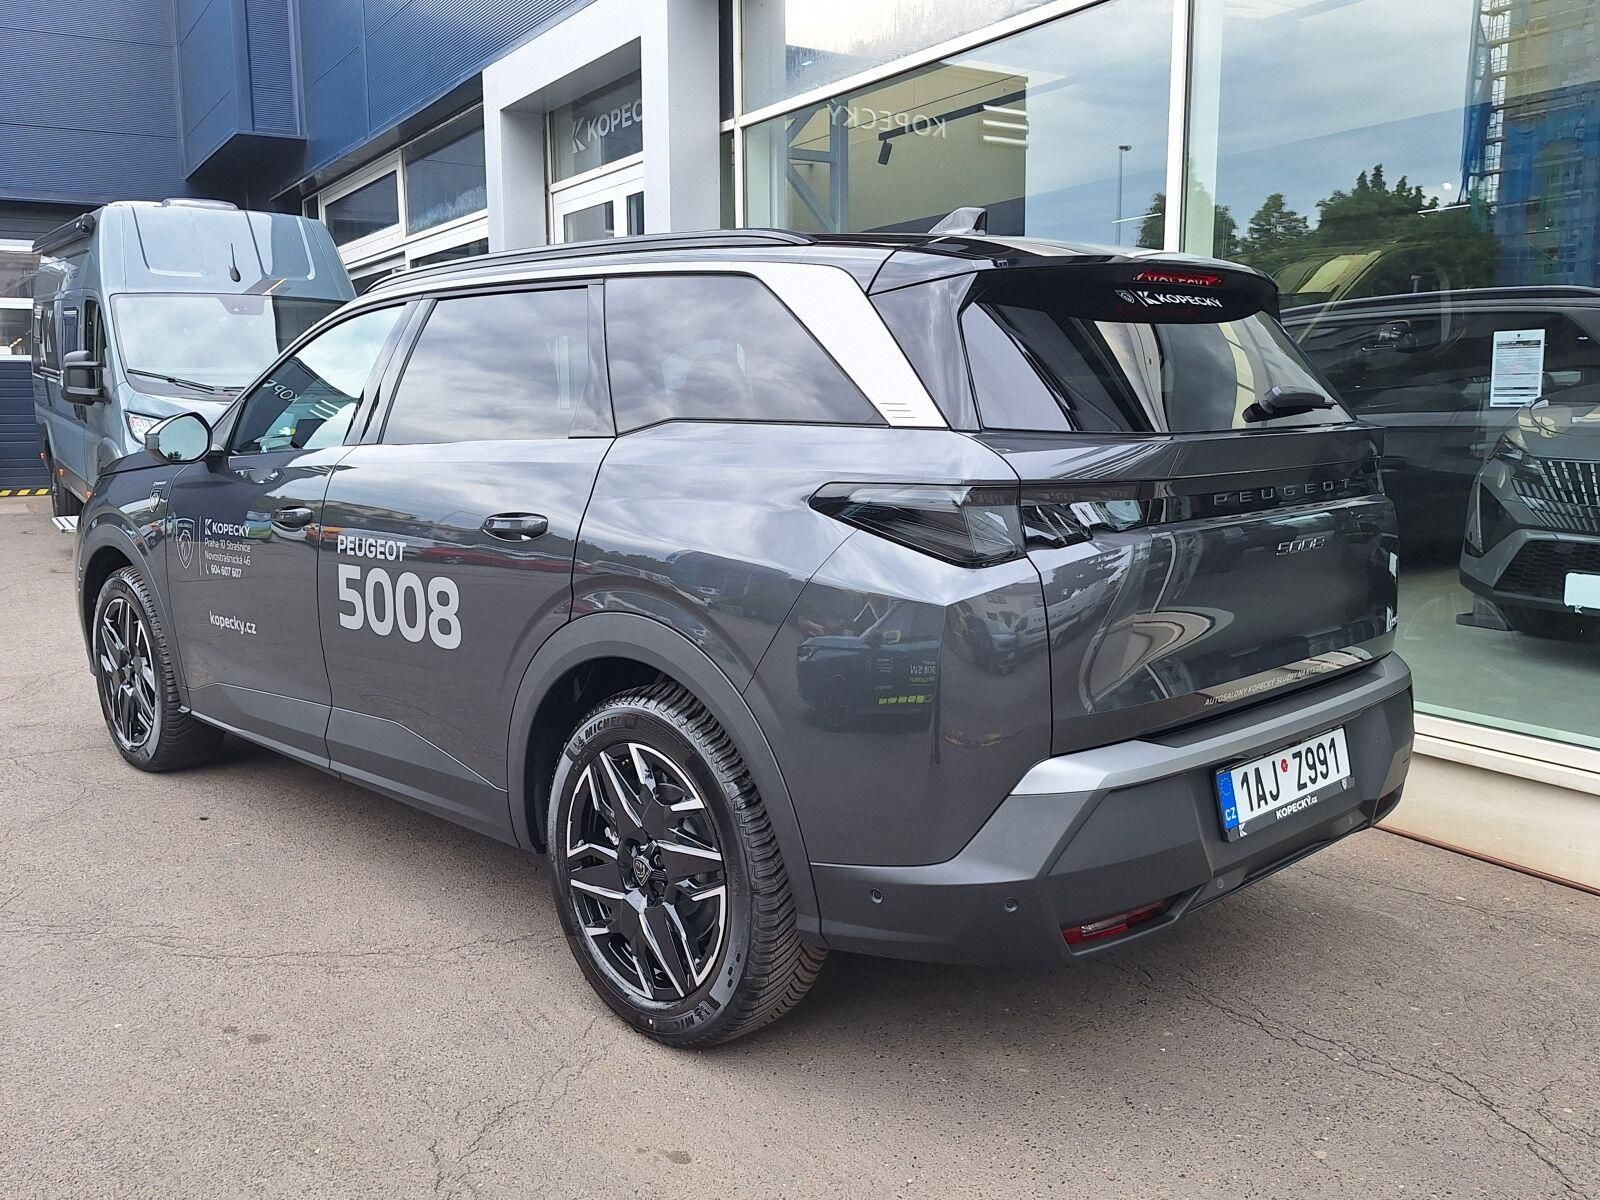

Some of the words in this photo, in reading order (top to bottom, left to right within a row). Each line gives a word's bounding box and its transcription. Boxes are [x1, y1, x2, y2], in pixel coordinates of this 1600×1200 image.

[1213, 478, 1350, 506] PEUGEOT
[204, 537, 219, 549] Praha
[337, 534, 407, 562] PEUGEOT
[1275, 535, 1326, 556] 5008
[210, 563, 221, 575] 604
[231, 567, 242, 579] 607
[338, 563, 462, 650] 5008
[209, 610, 257, 635] kopecky.cz
[1204, 687, 1249, 706] AUTOSALONY
[1240, 760, 1281, 812] 1AJ
[1292, 737, 1340, 792] Z991
[1225, 805, 1238, 822] CZ
